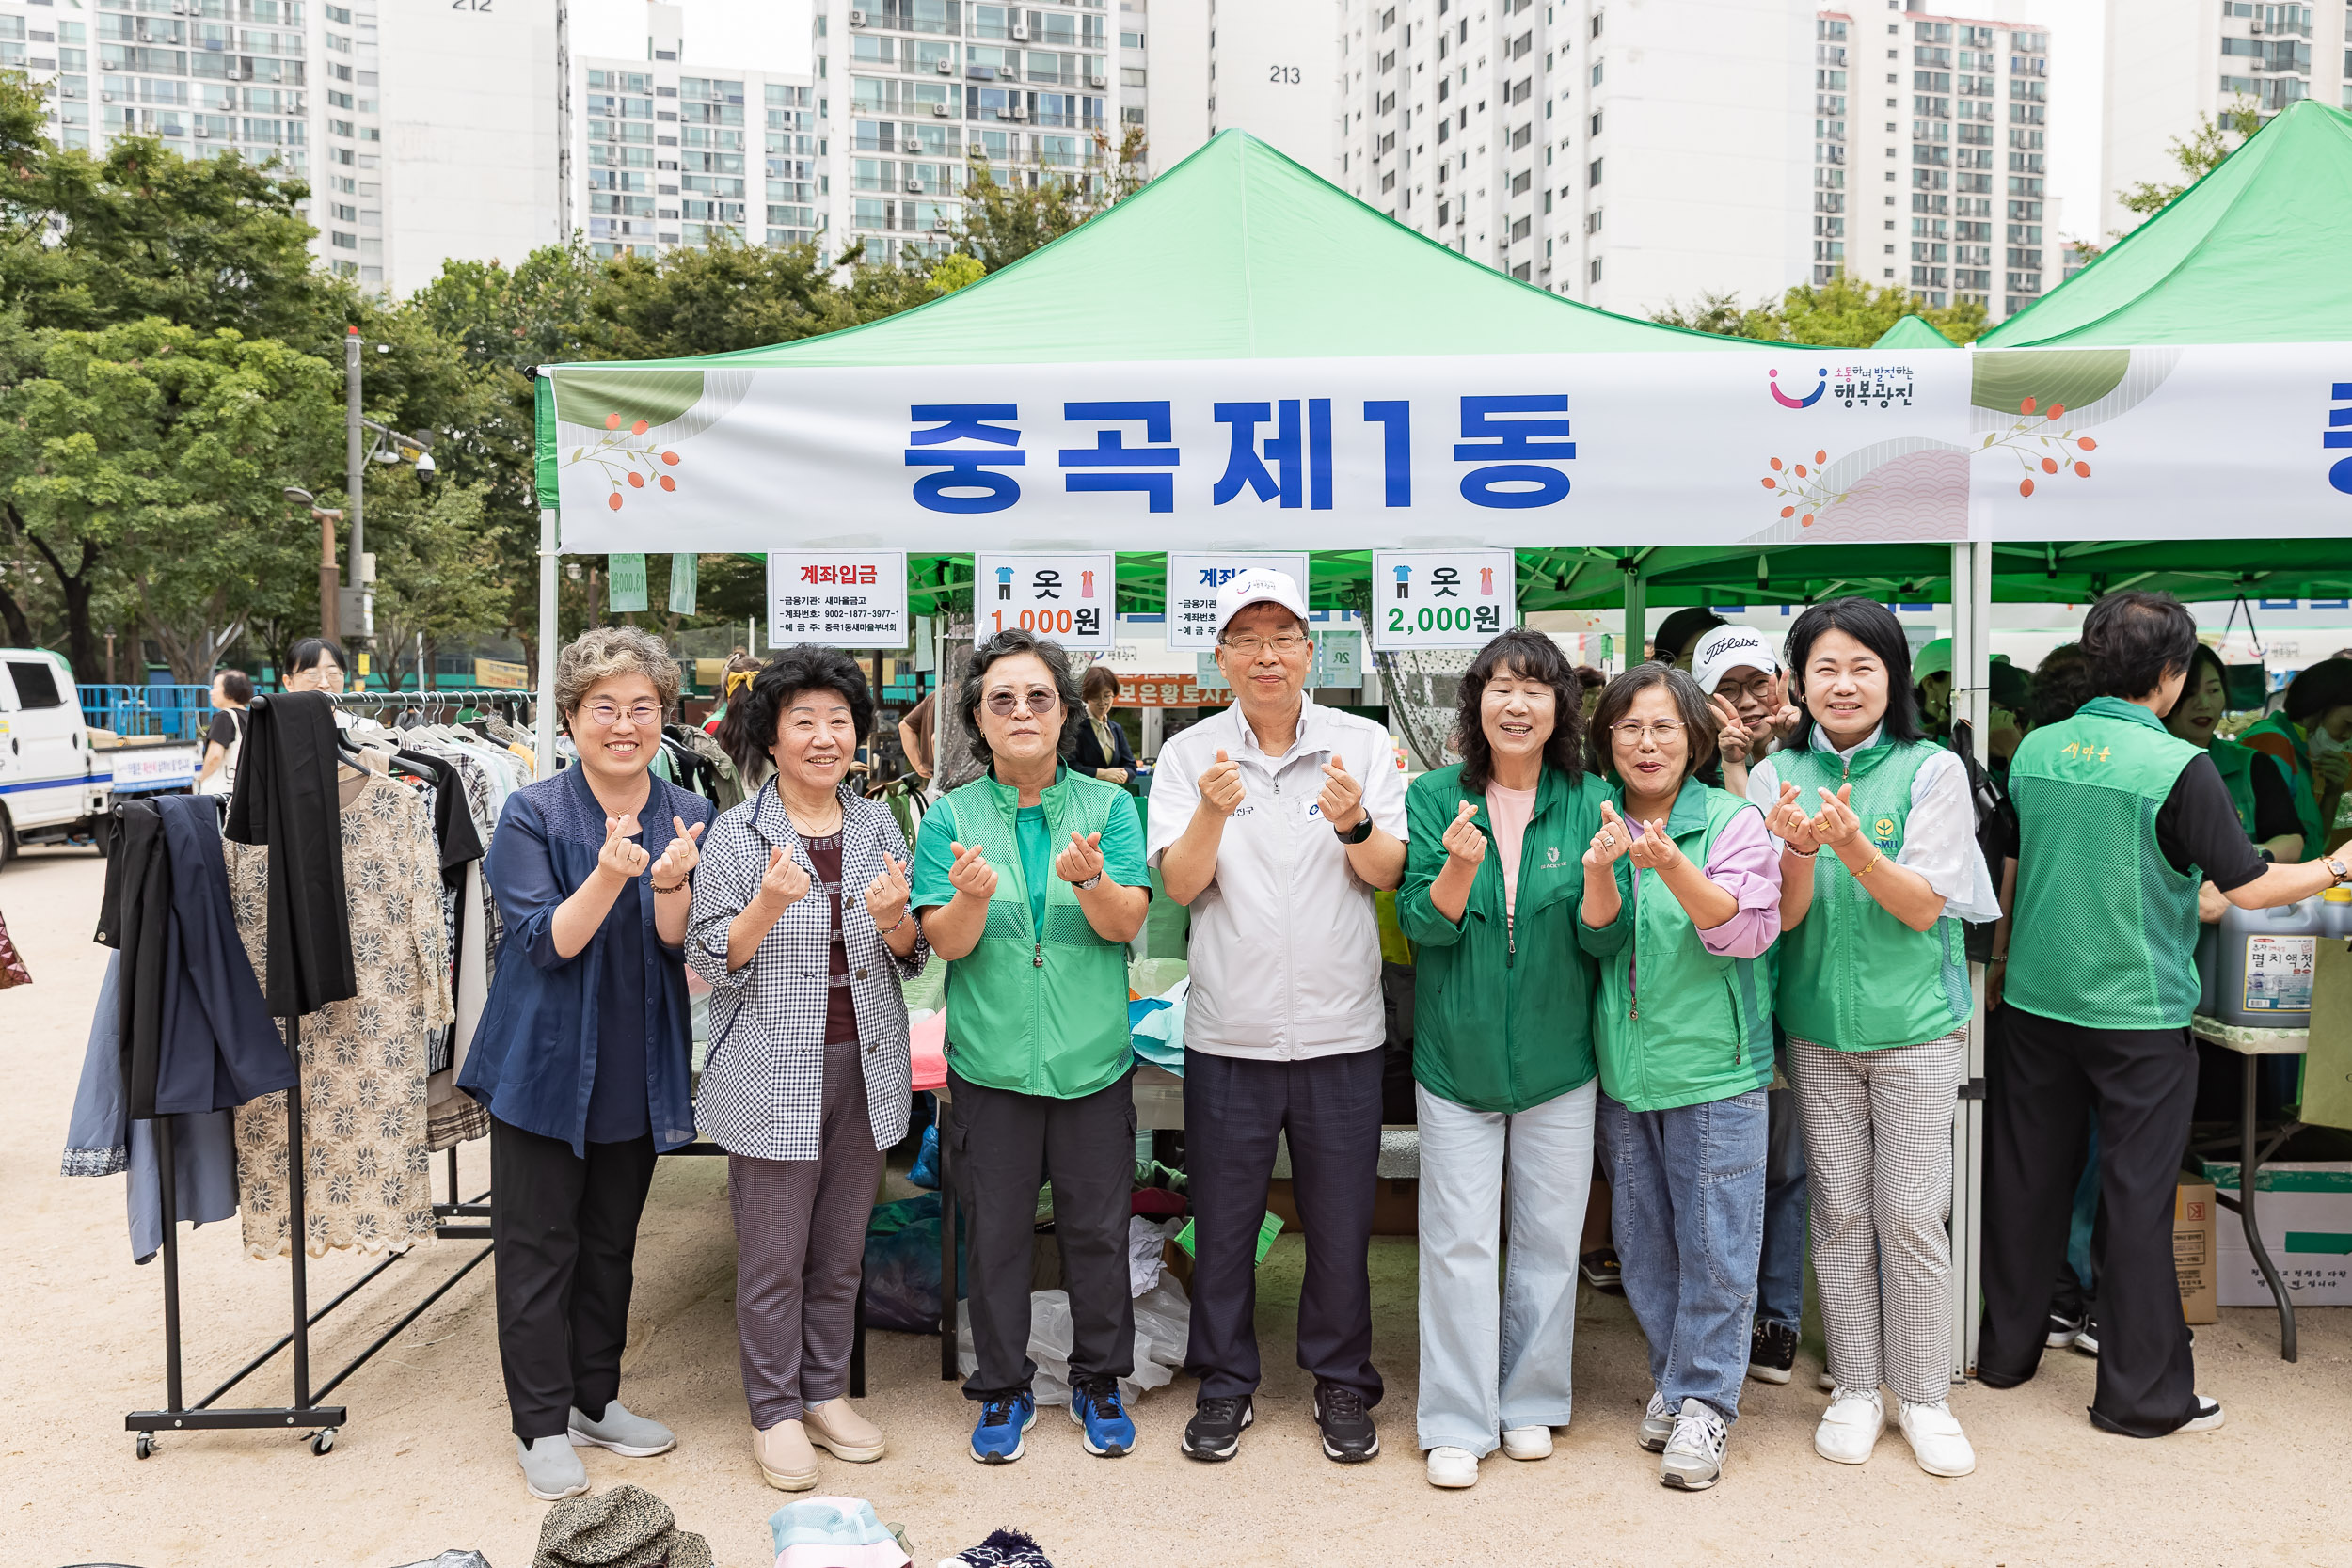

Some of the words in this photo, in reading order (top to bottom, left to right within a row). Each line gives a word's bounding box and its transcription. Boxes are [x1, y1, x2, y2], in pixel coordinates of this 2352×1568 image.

[1270, 65, 1300, 84] 213
[1835, 366, 1872, 382] 소통하며
[1874, 366, 1914, 382] 발전하는
[1834, 381, 1913, 408] 행복광진
[904, 393, 1577, 514] 중곡제1동
[800, 564, 878, 584] 계좌입금
[1430, 567, 1461, 597] 옷
[1032, 569, 1063, 600] 옷
[824, 596, 866, 605] 새마을금고
[824, 610, 899, 618] 9002-1877-3977-1
[991, 607, 1100, 636] 1000원
[1388, 605, 1500, 636] 2,000원
[824, 623, 897, 632] 중곡1동새마을부녀회
[1704, 638, 1758, 664] Titleist
[2061, 742, 2111, 762] 새마을
[1229, 806, 1254, 817] 진구
[1873, 840, 1898, 848] SMU
